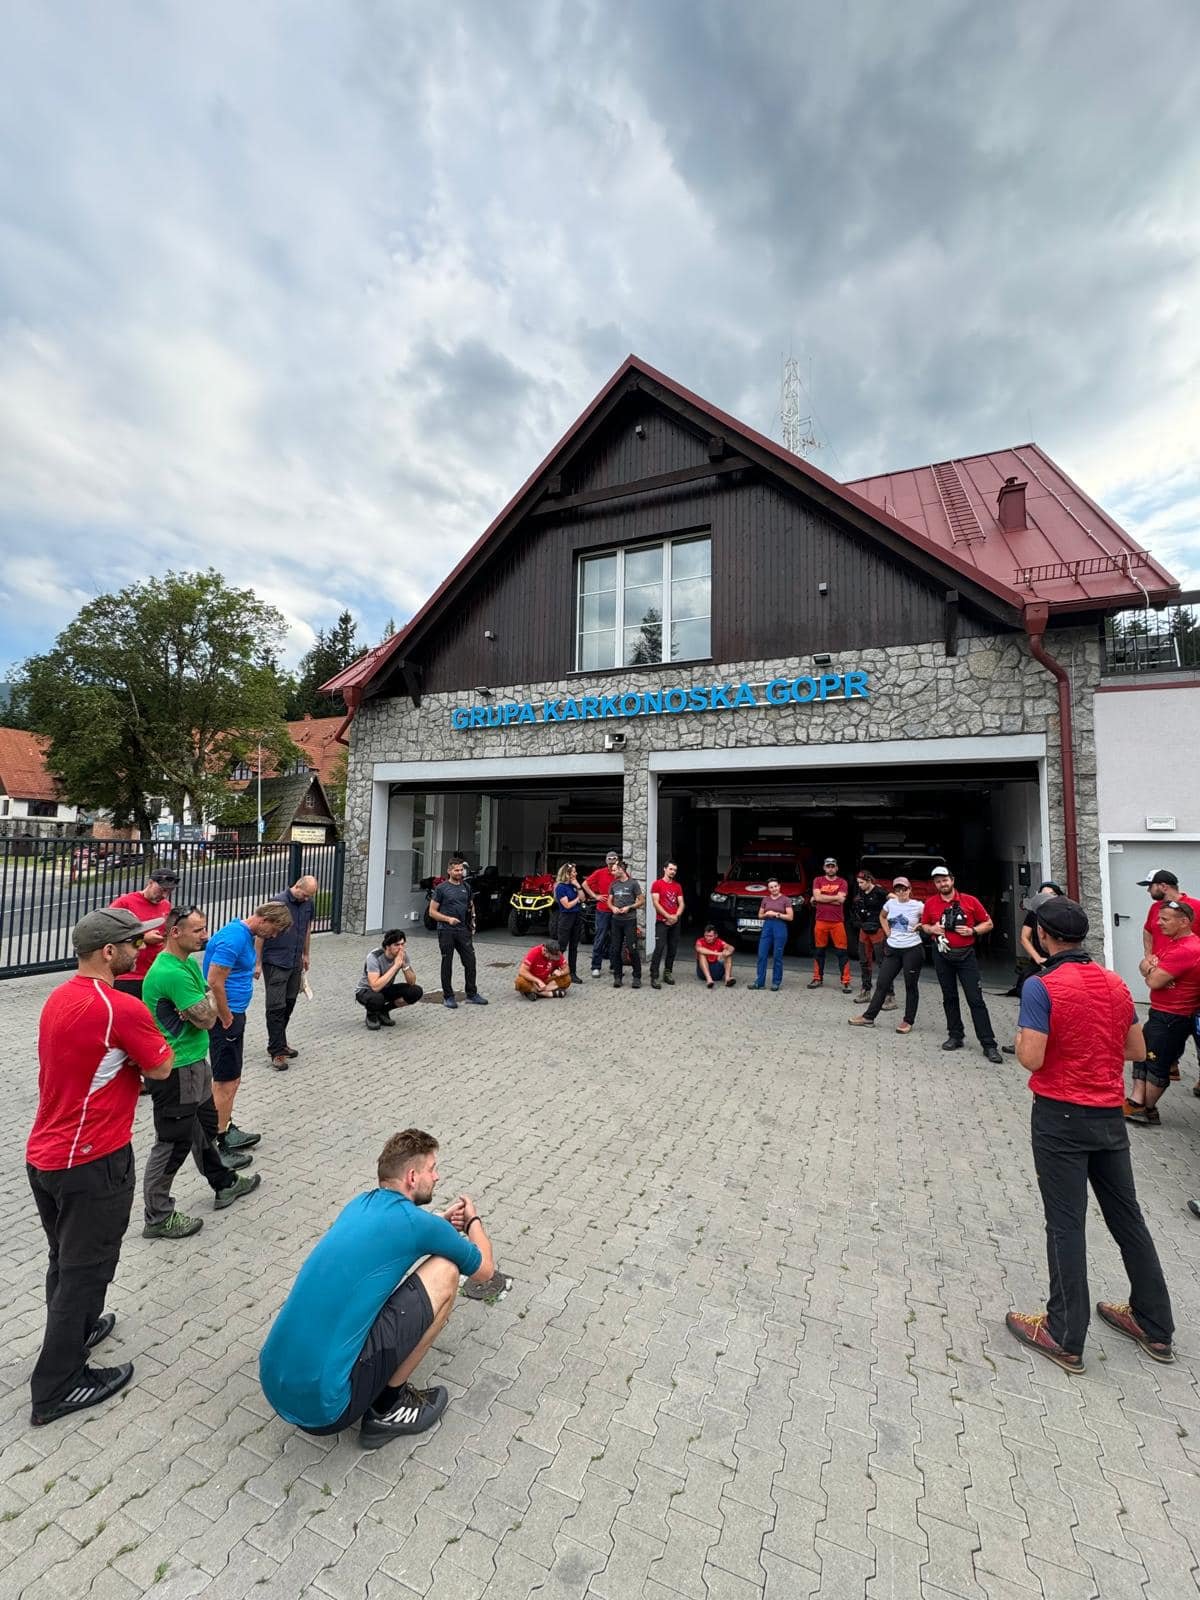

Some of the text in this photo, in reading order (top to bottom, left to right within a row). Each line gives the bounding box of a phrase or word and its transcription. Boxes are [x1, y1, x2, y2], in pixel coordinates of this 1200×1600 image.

[452, 671, 869, 729] GRUPA KARKONOSKA GOPR
